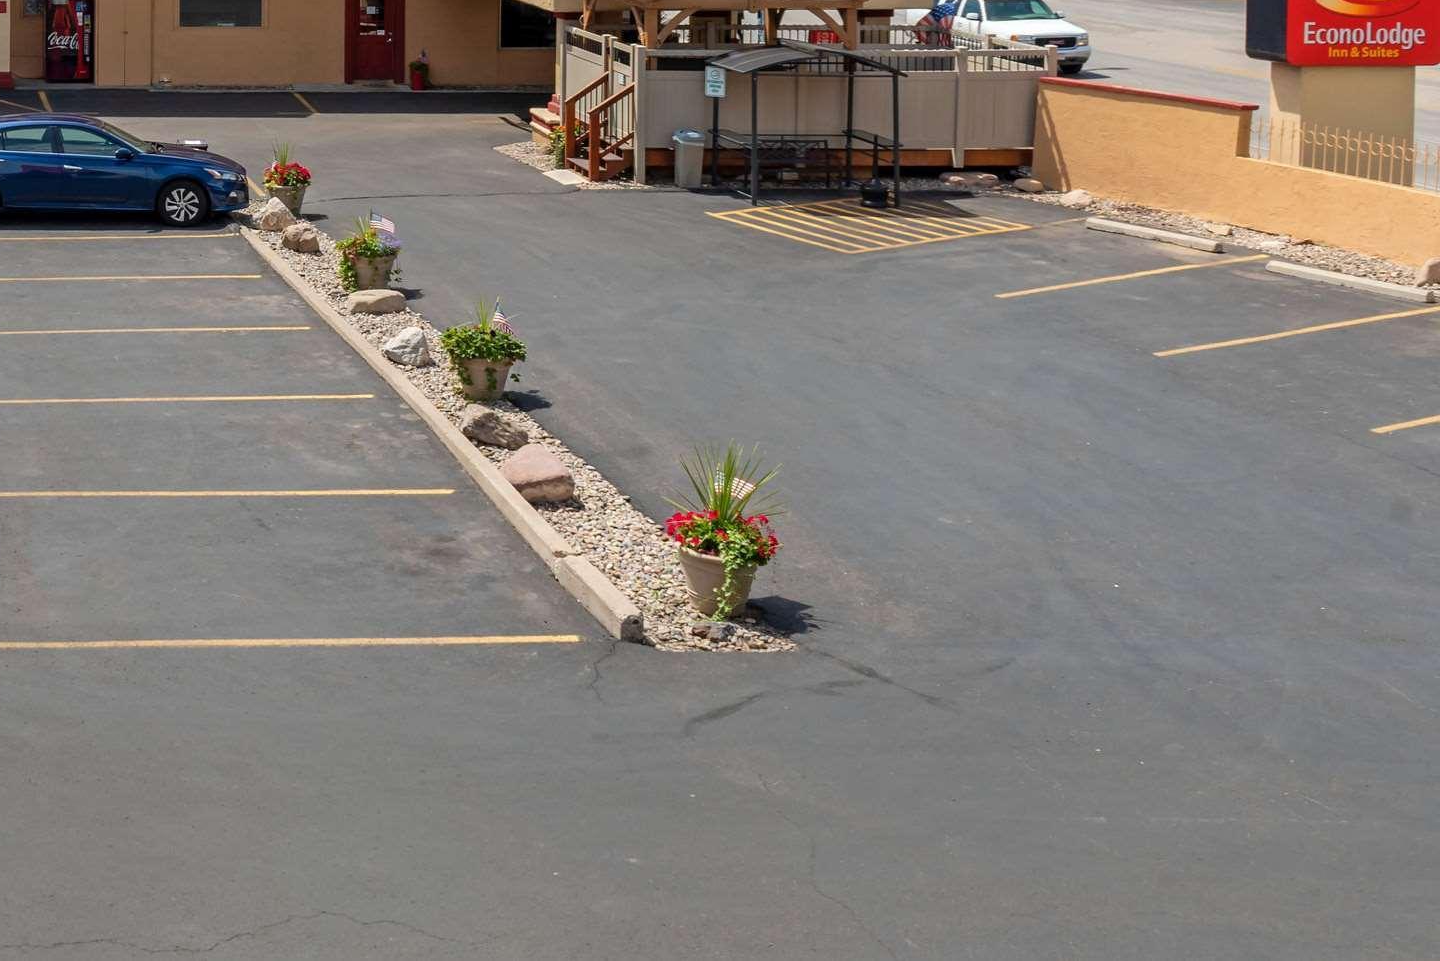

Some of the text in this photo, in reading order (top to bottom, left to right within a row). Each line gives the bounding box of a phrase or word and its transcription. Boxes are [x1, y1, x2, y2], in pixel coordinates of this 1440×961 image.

[1303, 21, 1425, 49] EconoLodge
[1328, 46, 1399, 57] Inn & Suites
